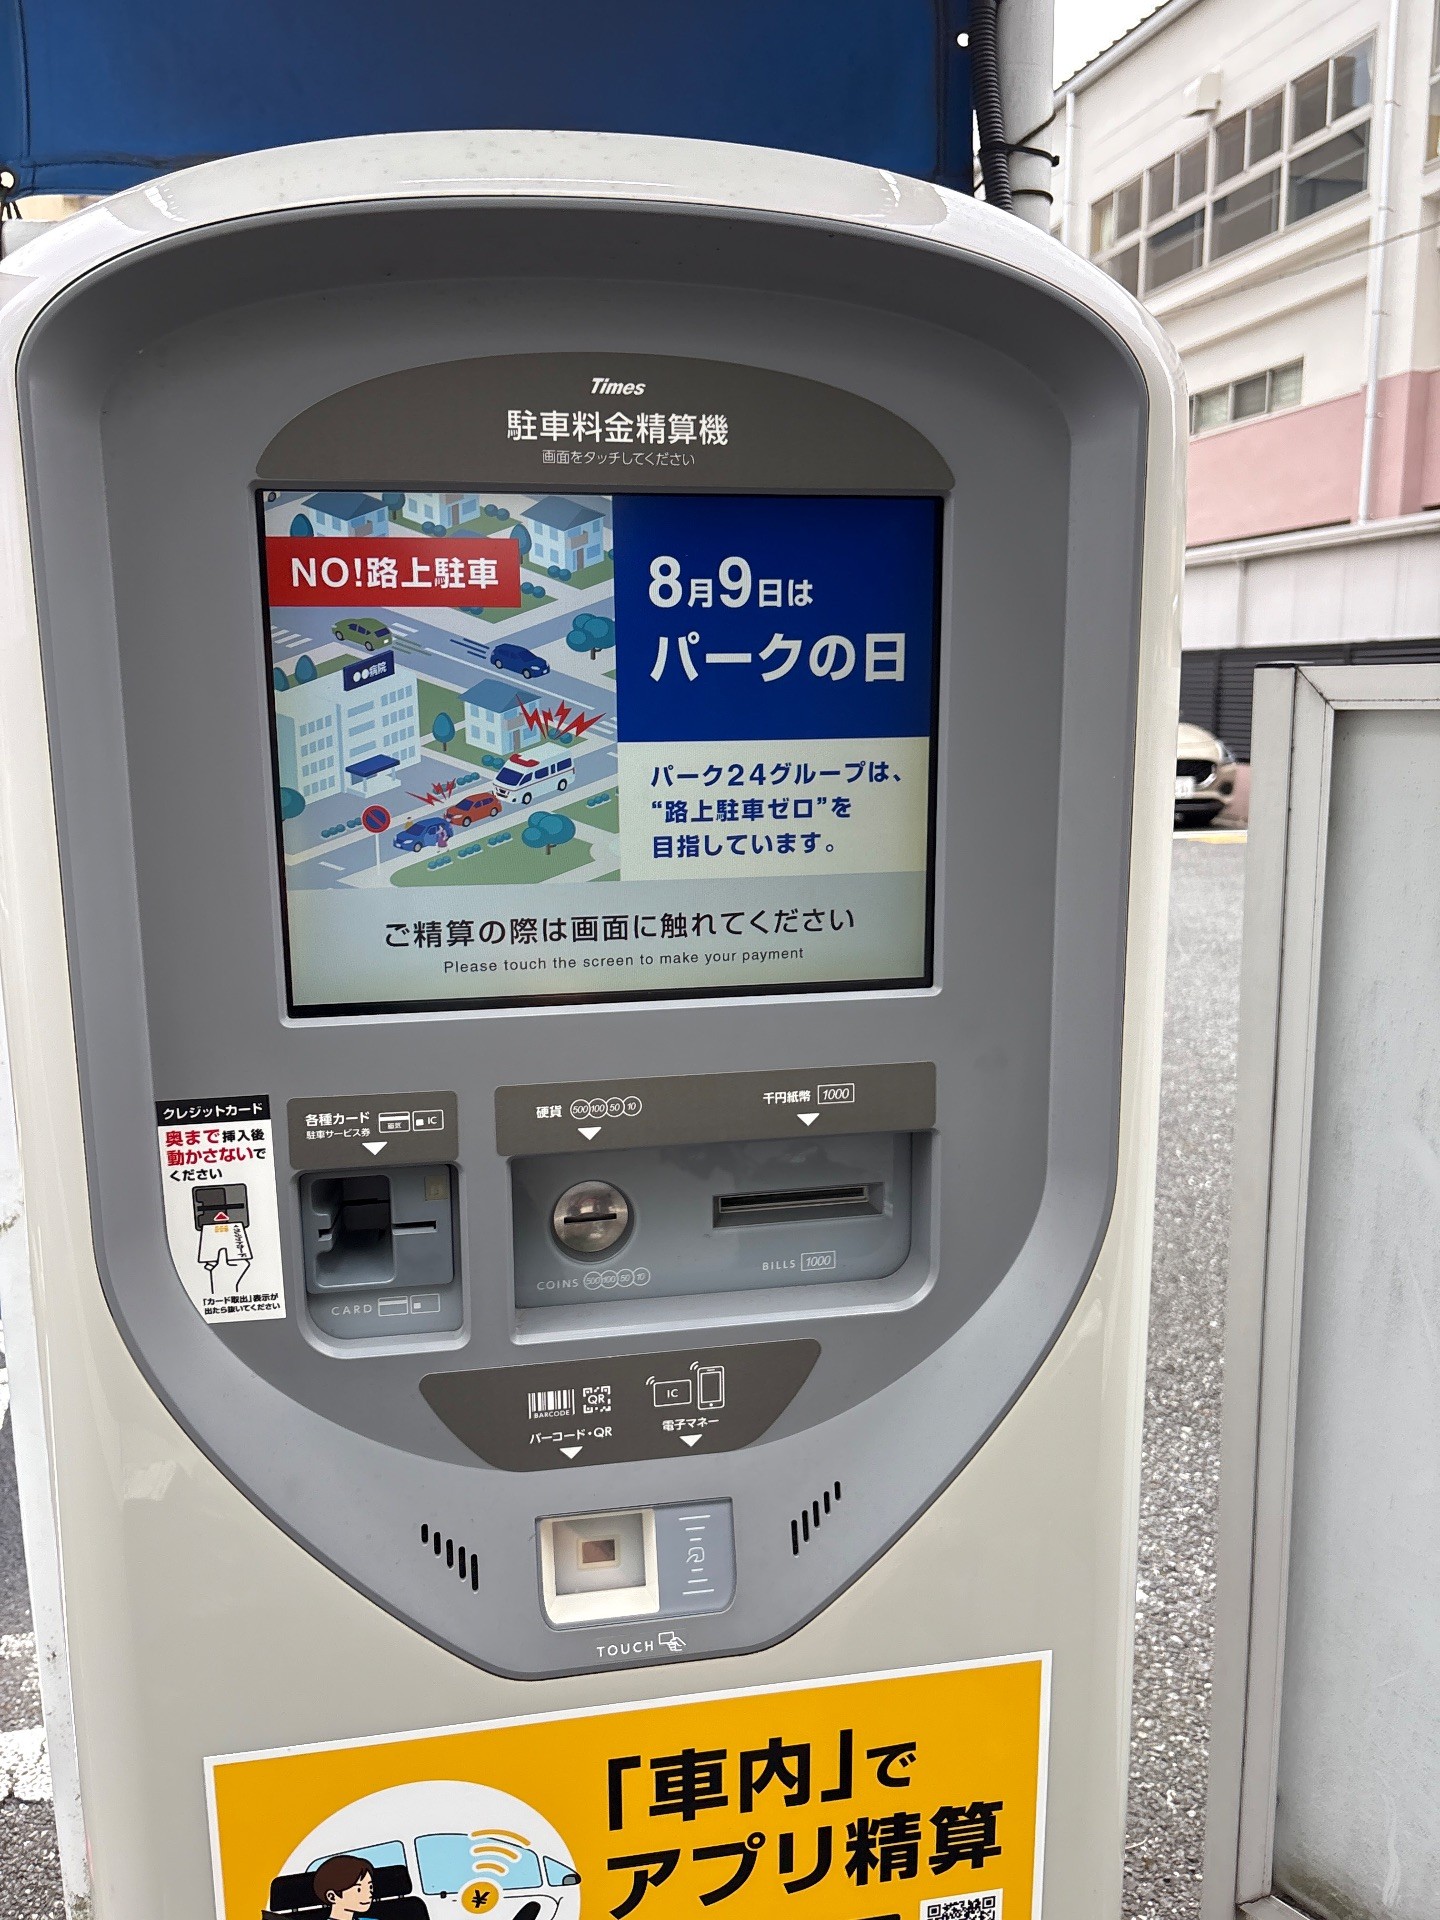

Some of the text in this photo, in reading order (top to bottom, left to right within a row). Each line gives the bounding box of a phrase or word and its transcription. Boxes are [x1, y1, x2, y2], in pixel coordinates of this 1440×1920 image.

[591, 377, 646, 396] Times
[507, 409, 729, 446] 駐車料金精算機
[542, 449, 695, 467] 画面をタッチしてください
[291, 556, 499, 589] NO!路上駐車
[648, 555, 814, 608] 8月9日は
[649, 631, 906, 683] パークの日
[652, 832, 834, 859] 目指しています。
[385, 908, 855, 949] ご精算の際は画面に触れてください
[443, 947, 804, 974] Please touch the screen to make your payment
[762, 1087, 850, 1105] 千円紙幣 1000
[162, 1102, 263, 1121] クレジットカード
[535, 1105, 562, 1119] 硬貨
[572, 1101, 637, 1114] 500 100 50 10
[305, 1111, 370, 1127] 各種カード
[427, 1116, 438, 1125] IC
[165, 1128, 265, 1147] 奥まで挿入後
[306, 1127, 371, 1140] 駐車サービス券
[167, 1147, 267, 1167] 動かさないで
[169, 1168, 223, 1182] ください
[762, 1255, 831, 1271] BILLS 1000
[536, 1278, 579, 1291] COINS
[636, 1272, 646, 1281] 10
[331, 1304, 373, 1316] CARD
[587, 1393, 605, 1405] QR
[667, 1389, 679, 1399] IC
[533, 1409, 570, 1419] BARCODE
[662, 1417, 720, 1432] 電子マネー
[596, 1640, 654, 1658] TOUCH
[607, 1728, 918, 1832] 「車内」で
[606, 1800, 1004, 1920] アプリ精算
